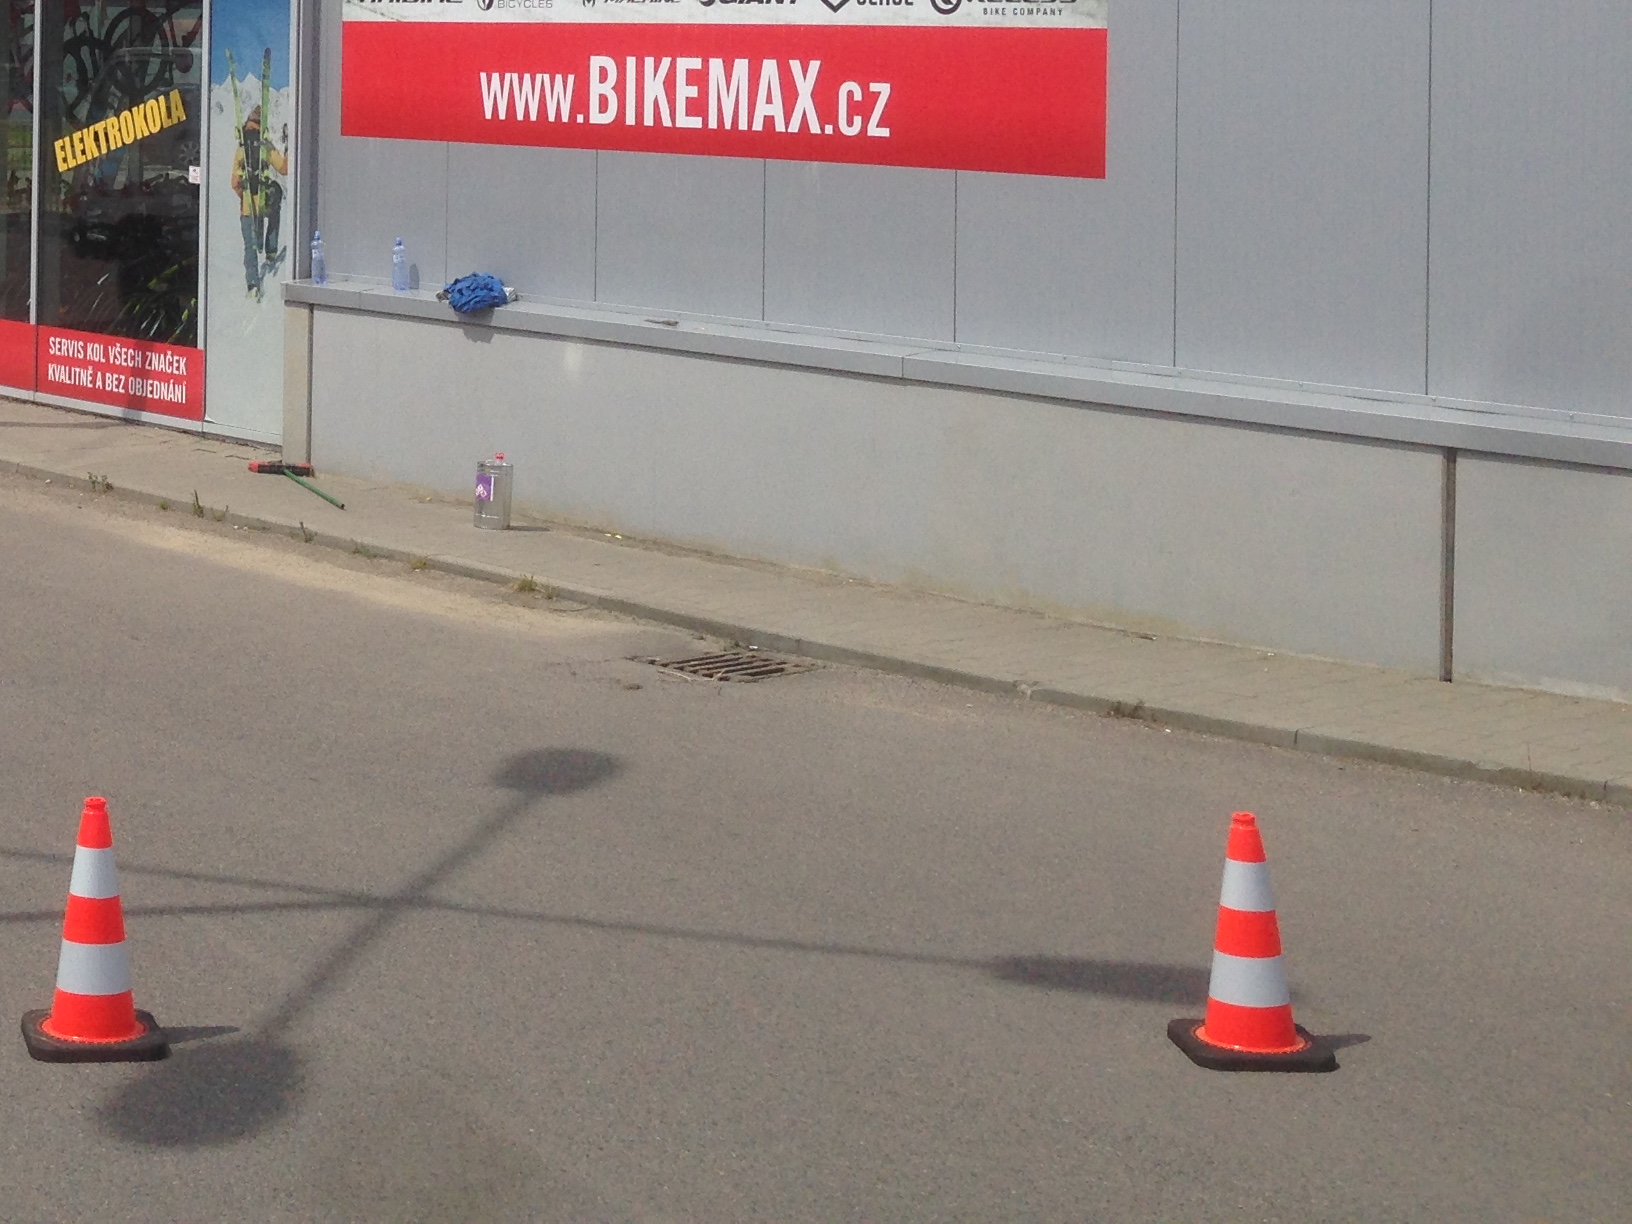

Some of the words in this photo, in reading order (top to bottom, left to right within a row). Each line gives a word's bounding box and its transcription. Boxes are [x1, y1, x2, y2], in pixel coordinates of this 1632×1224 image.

[497, 0, 553, 9] BICYCLES
[982, 7, 1007, 16] BIKE
[1012, 7, 1063, 16] COMPANY
[54, 88, 187, 173] ELEKTROKOLA
[49, 336, 84, 359] SERVIS
[87, 342, 106, 363] KOL
[109, 343, 142, 368] VŠECH
[145, 350, 187, 376] ZNAČEK
[48, 363, 93, 388] KVALITNĚ
[96, 371, 103, 390] A
[105, 372, 125, 394] BEZ
[128, 377, 187, 404] OBJEDNÁNÍ
